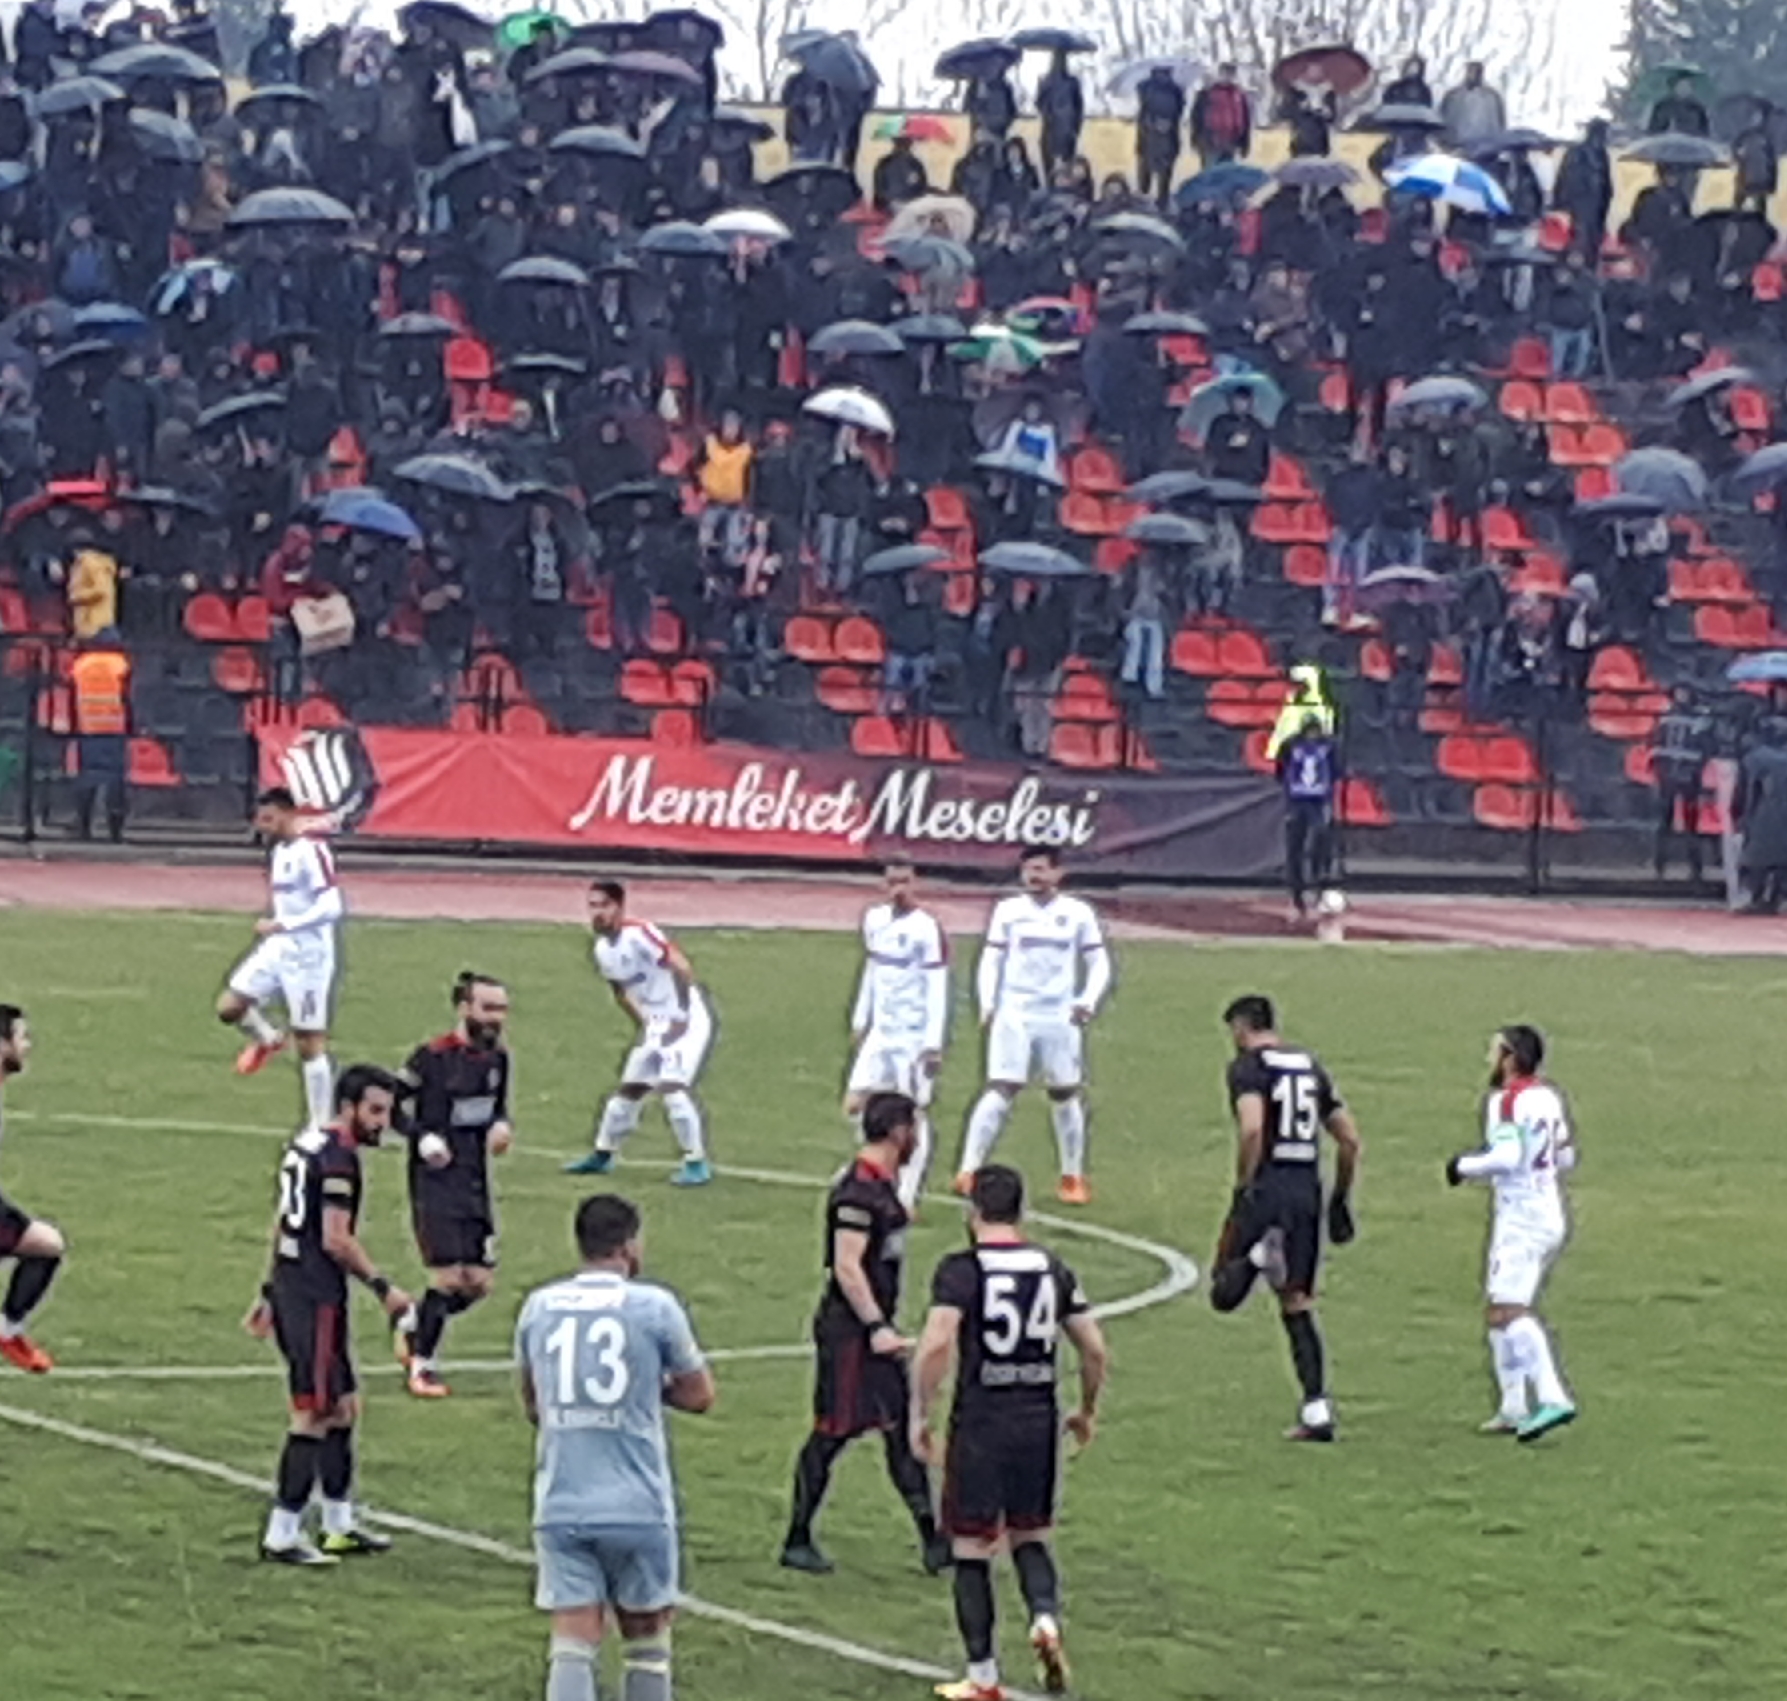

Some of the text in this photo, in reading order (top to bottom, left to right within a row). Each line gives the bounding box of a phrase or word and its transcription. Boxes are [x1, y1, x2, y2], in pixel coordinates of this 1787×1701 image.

[570, 754, 1100, 846] Memleket Meselesi
[1272, 1073, 1319, 1141] 15
[982, 1273, 1059, 1355] 54
[545, 1316, 630, 1405] 13
